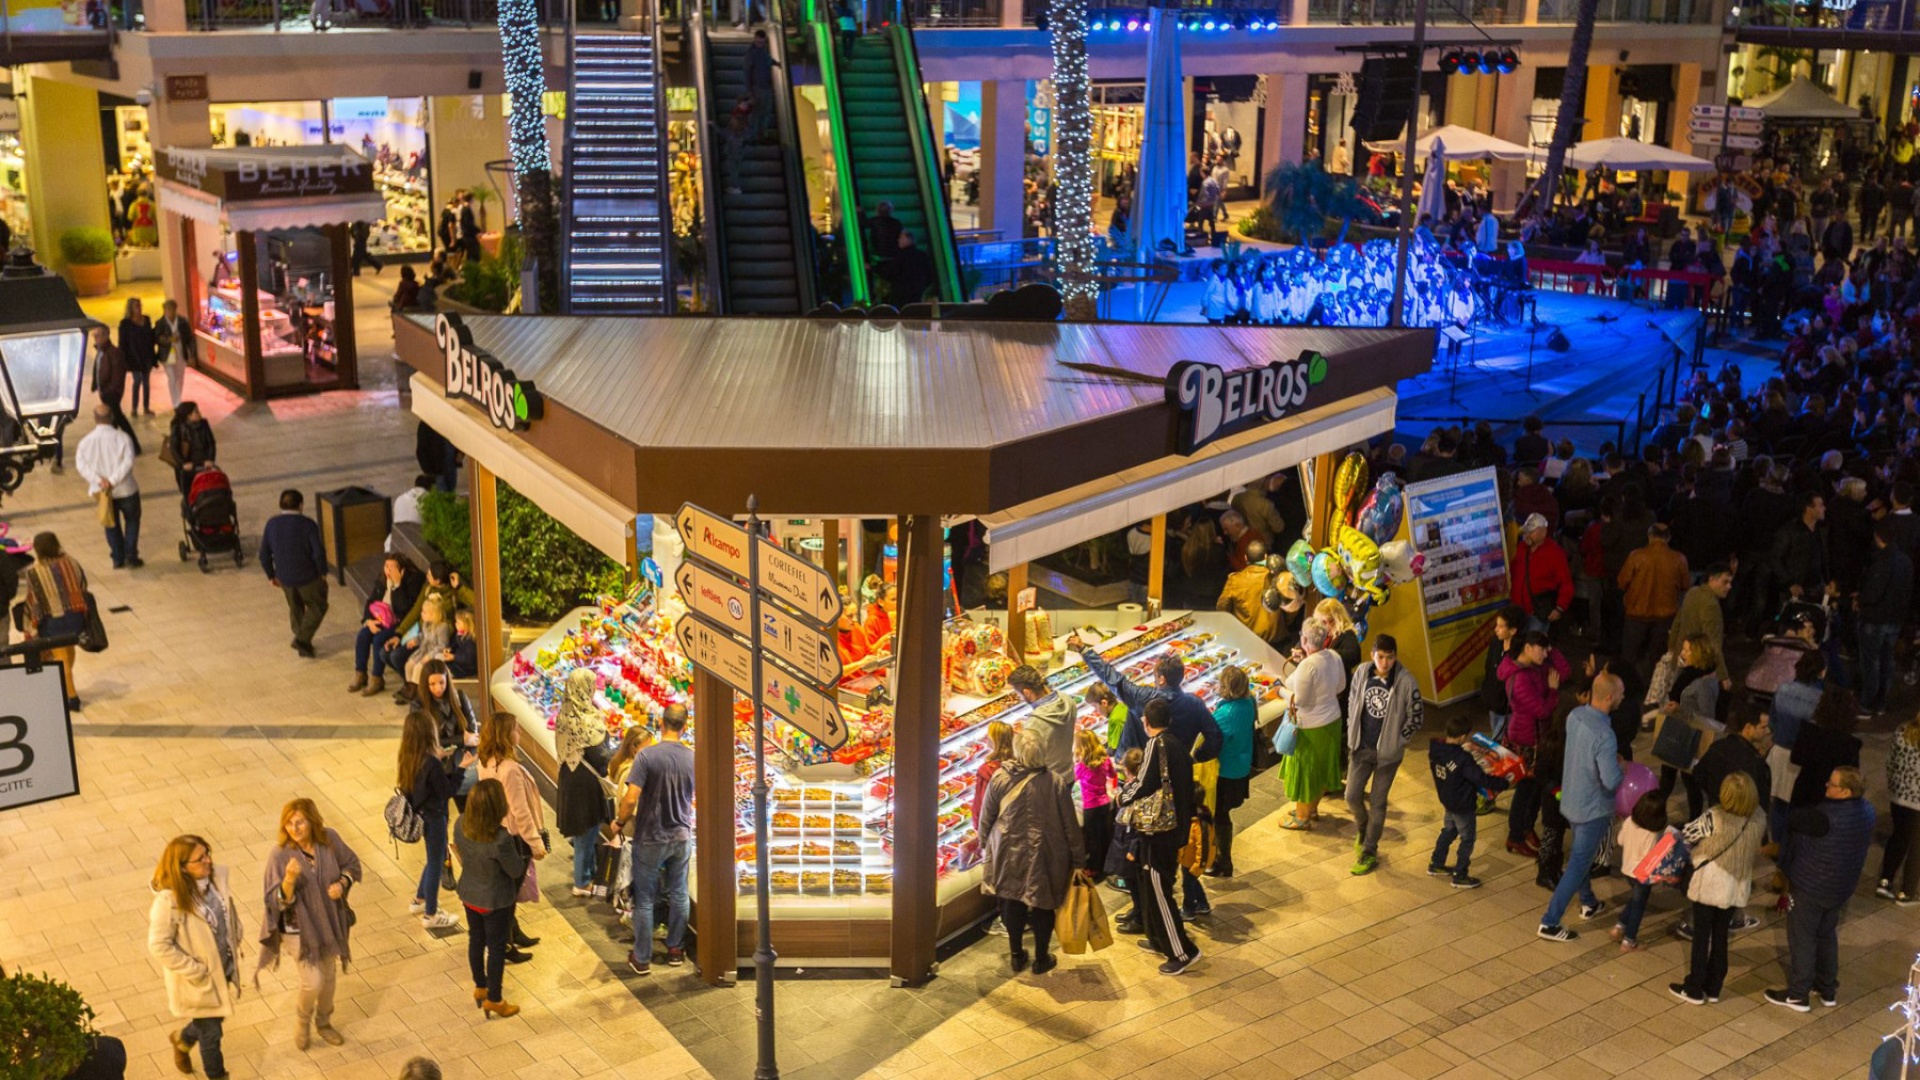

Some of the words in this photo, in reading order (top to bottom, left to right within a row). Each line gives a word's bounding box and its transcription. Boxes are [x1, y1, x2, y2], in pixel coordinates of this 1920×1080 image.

[238, 155, 362, 183] BEHER
[436, 313, 515, 430] BELROS
[1178, 363, 1308, 446] BELROS
[703, 526, 741, 560] Alcampo
[768, 554, 808, 584] CORTEFIEL
